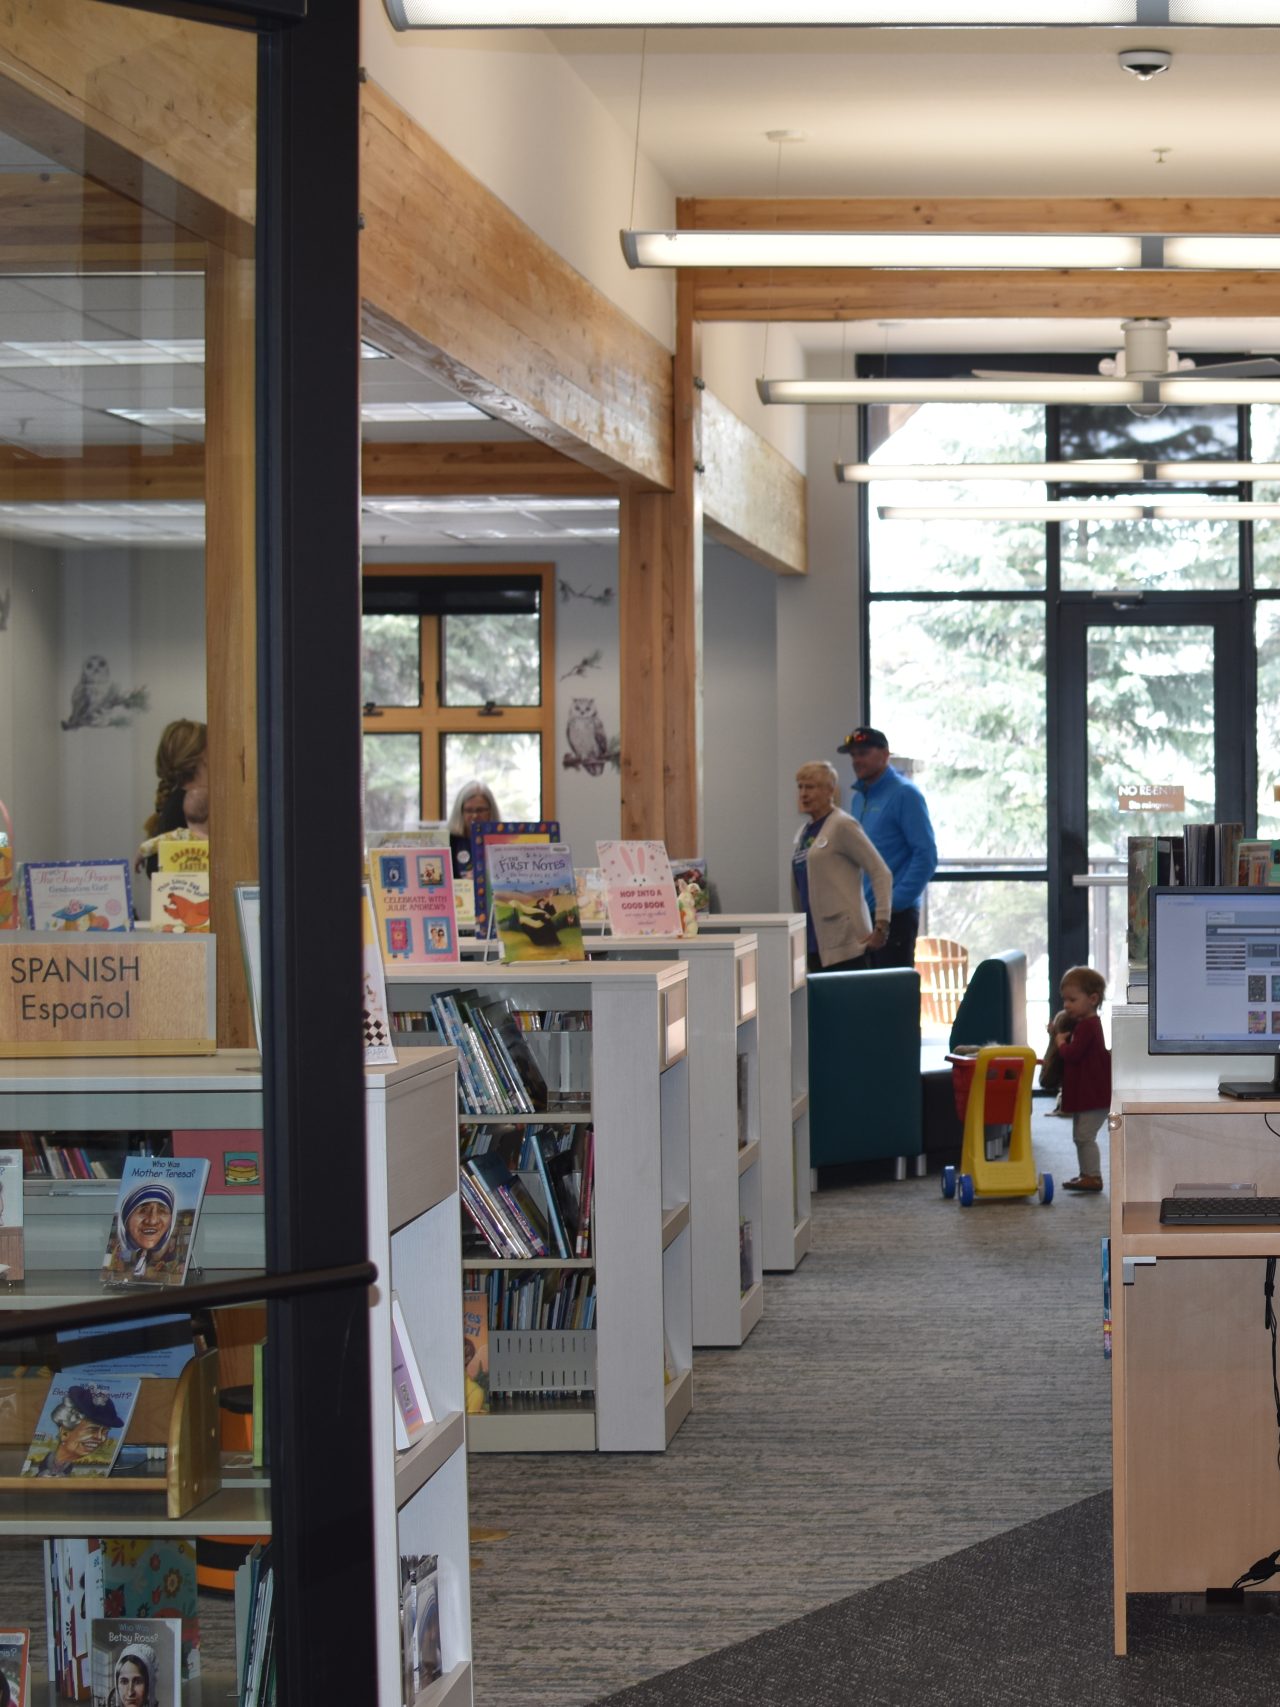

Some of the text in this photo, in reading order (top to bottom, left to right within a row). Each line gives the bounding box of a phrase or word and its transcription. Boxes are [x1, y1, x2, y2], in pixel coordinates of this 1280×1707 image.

[1118, 785, 1138, 796] NO
[499, 857, 566, 873] FIRST NOTES
[620, 889, 635, 898] HOP
[637, 889, 656, 897] INTO
[383, 895, 448, 905] CELEBRATE WITH
[386, 903, 446, 912] JULIE ANDREWS
[621, 901, 665, 910] GOOD BOOK
[11, 956, 140, 983] SPANISH
[22, 990, 130, 1028] Español
[152, 1160, 181, 1168] Who Was
[131, 1168, 197, 1179] Mother Teresa?
[118, 1623, 134, 1631] Who
[108, 1632, 159, 1643] Betsy Ross?
